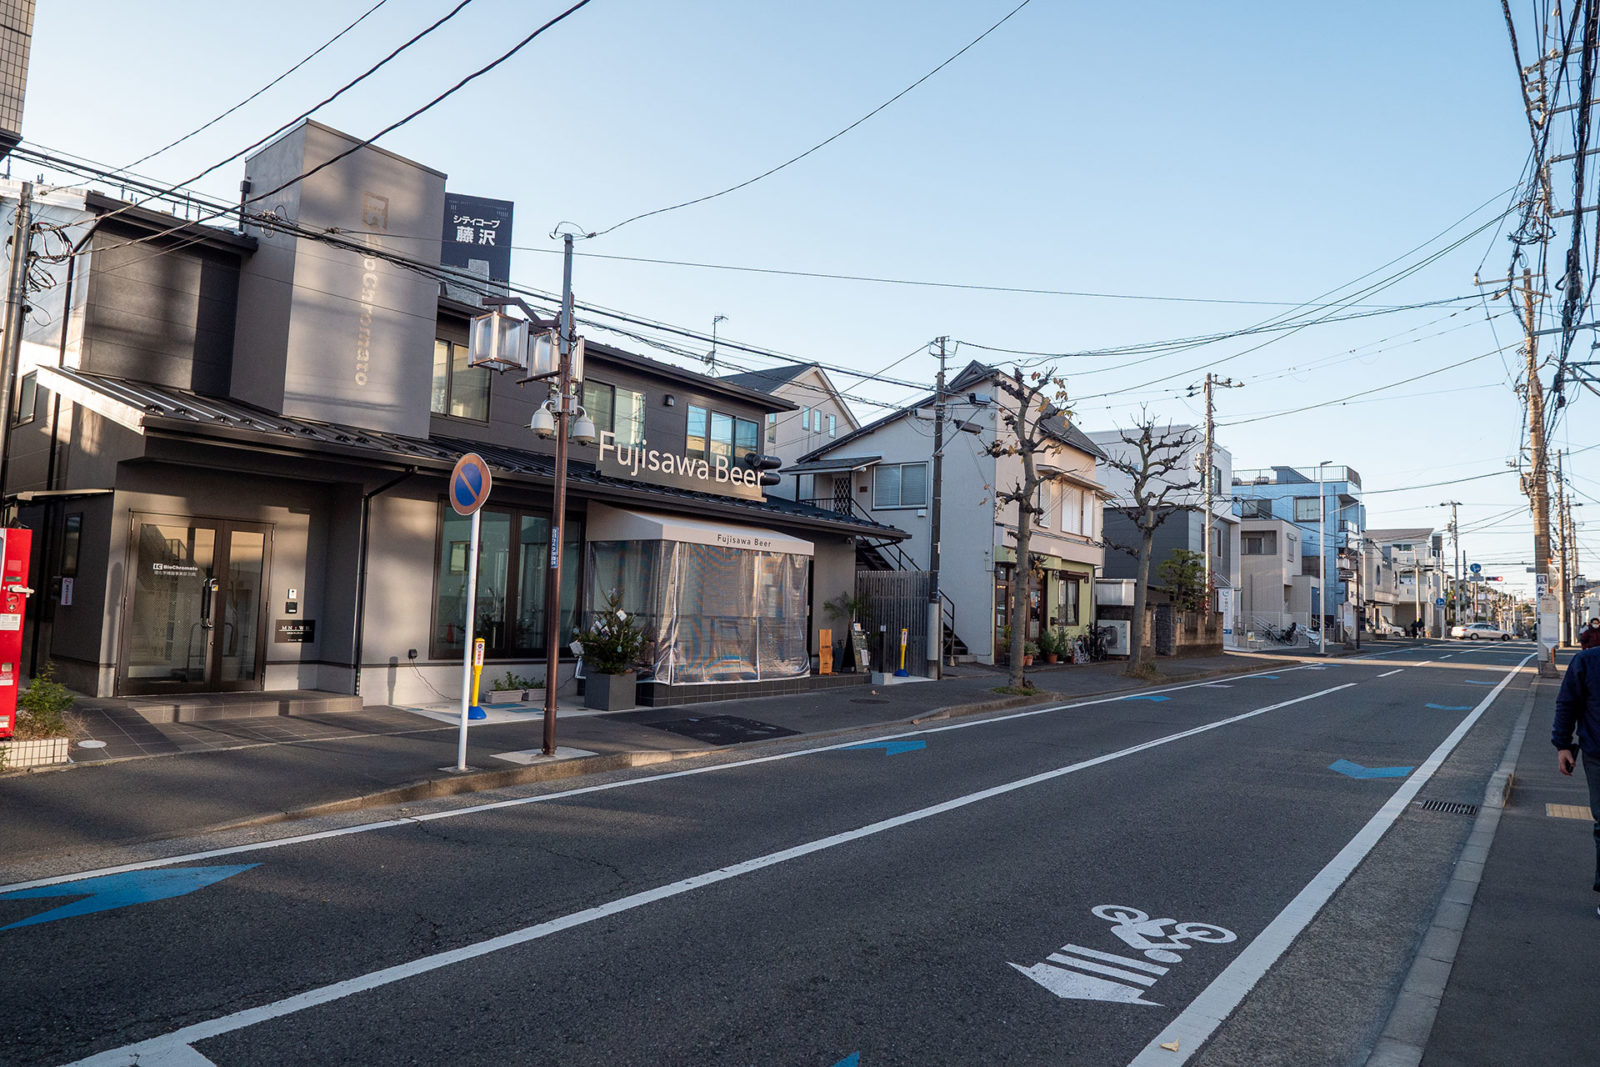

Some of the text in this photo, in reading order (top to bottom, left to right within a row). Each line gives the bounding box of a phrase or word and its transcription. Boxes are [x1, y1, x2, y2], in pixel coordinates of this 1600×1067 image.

[453, 215, 500, 228] シティコープ
[456, 226, 496, 246] 藤沢
[599, 430, 765, 489] Fujisawa Beer
[717, 534, 771, 547] Fujisawa Beer
